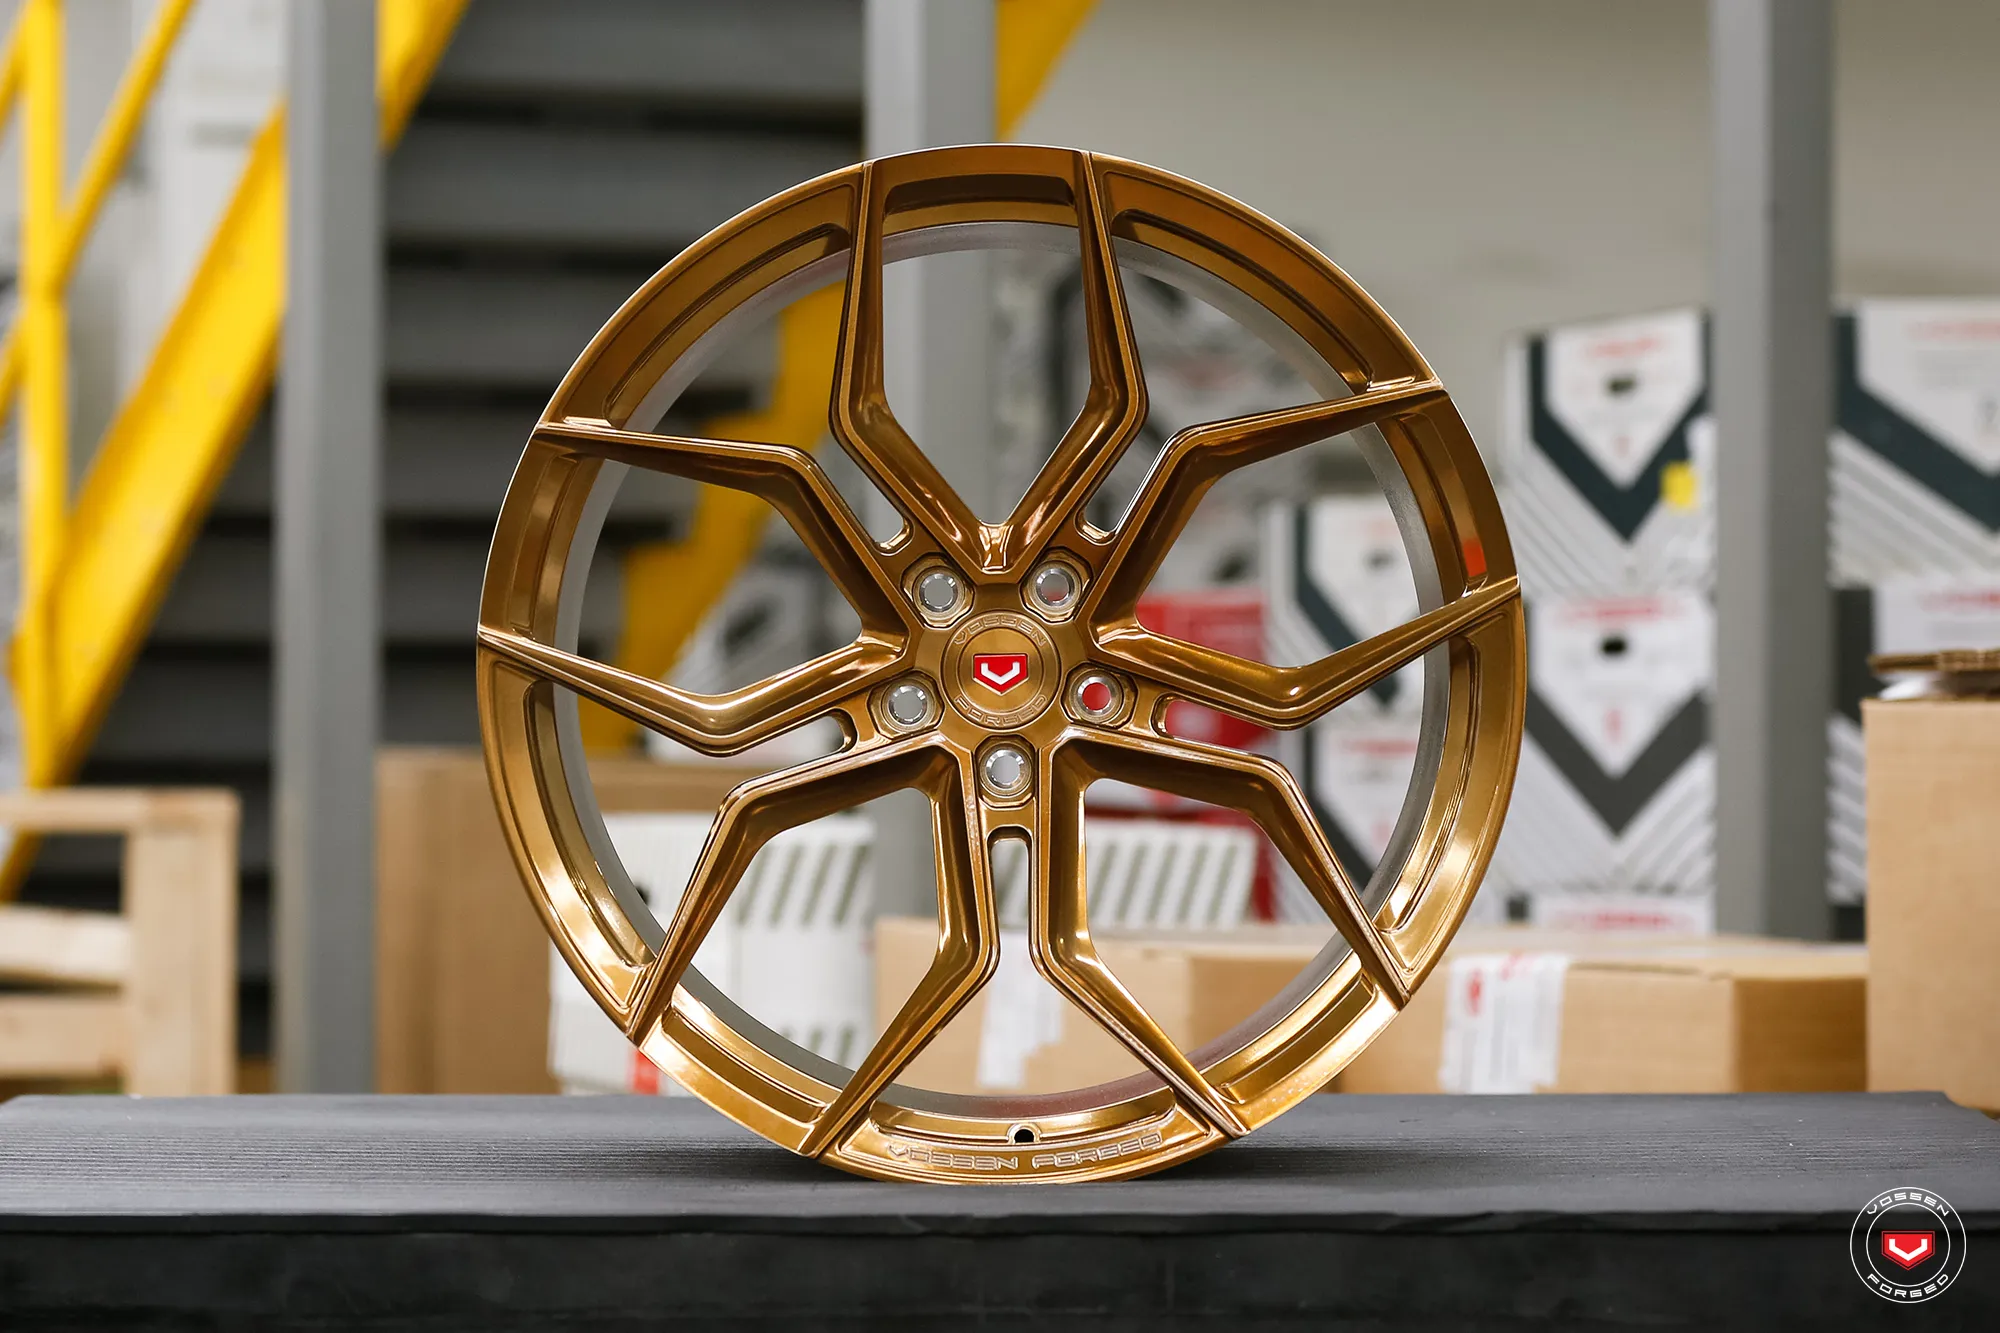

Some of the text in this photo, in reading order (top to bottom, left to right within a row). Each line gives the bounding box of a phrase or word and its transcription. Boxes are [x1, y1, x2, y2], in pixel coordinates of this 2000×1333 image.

[954, 615, 1047, 647] VOSSEN
[954, 694, 1048, 727] FORGED
[888, 1131, 1163, 1170] VOSSEN FORGED
